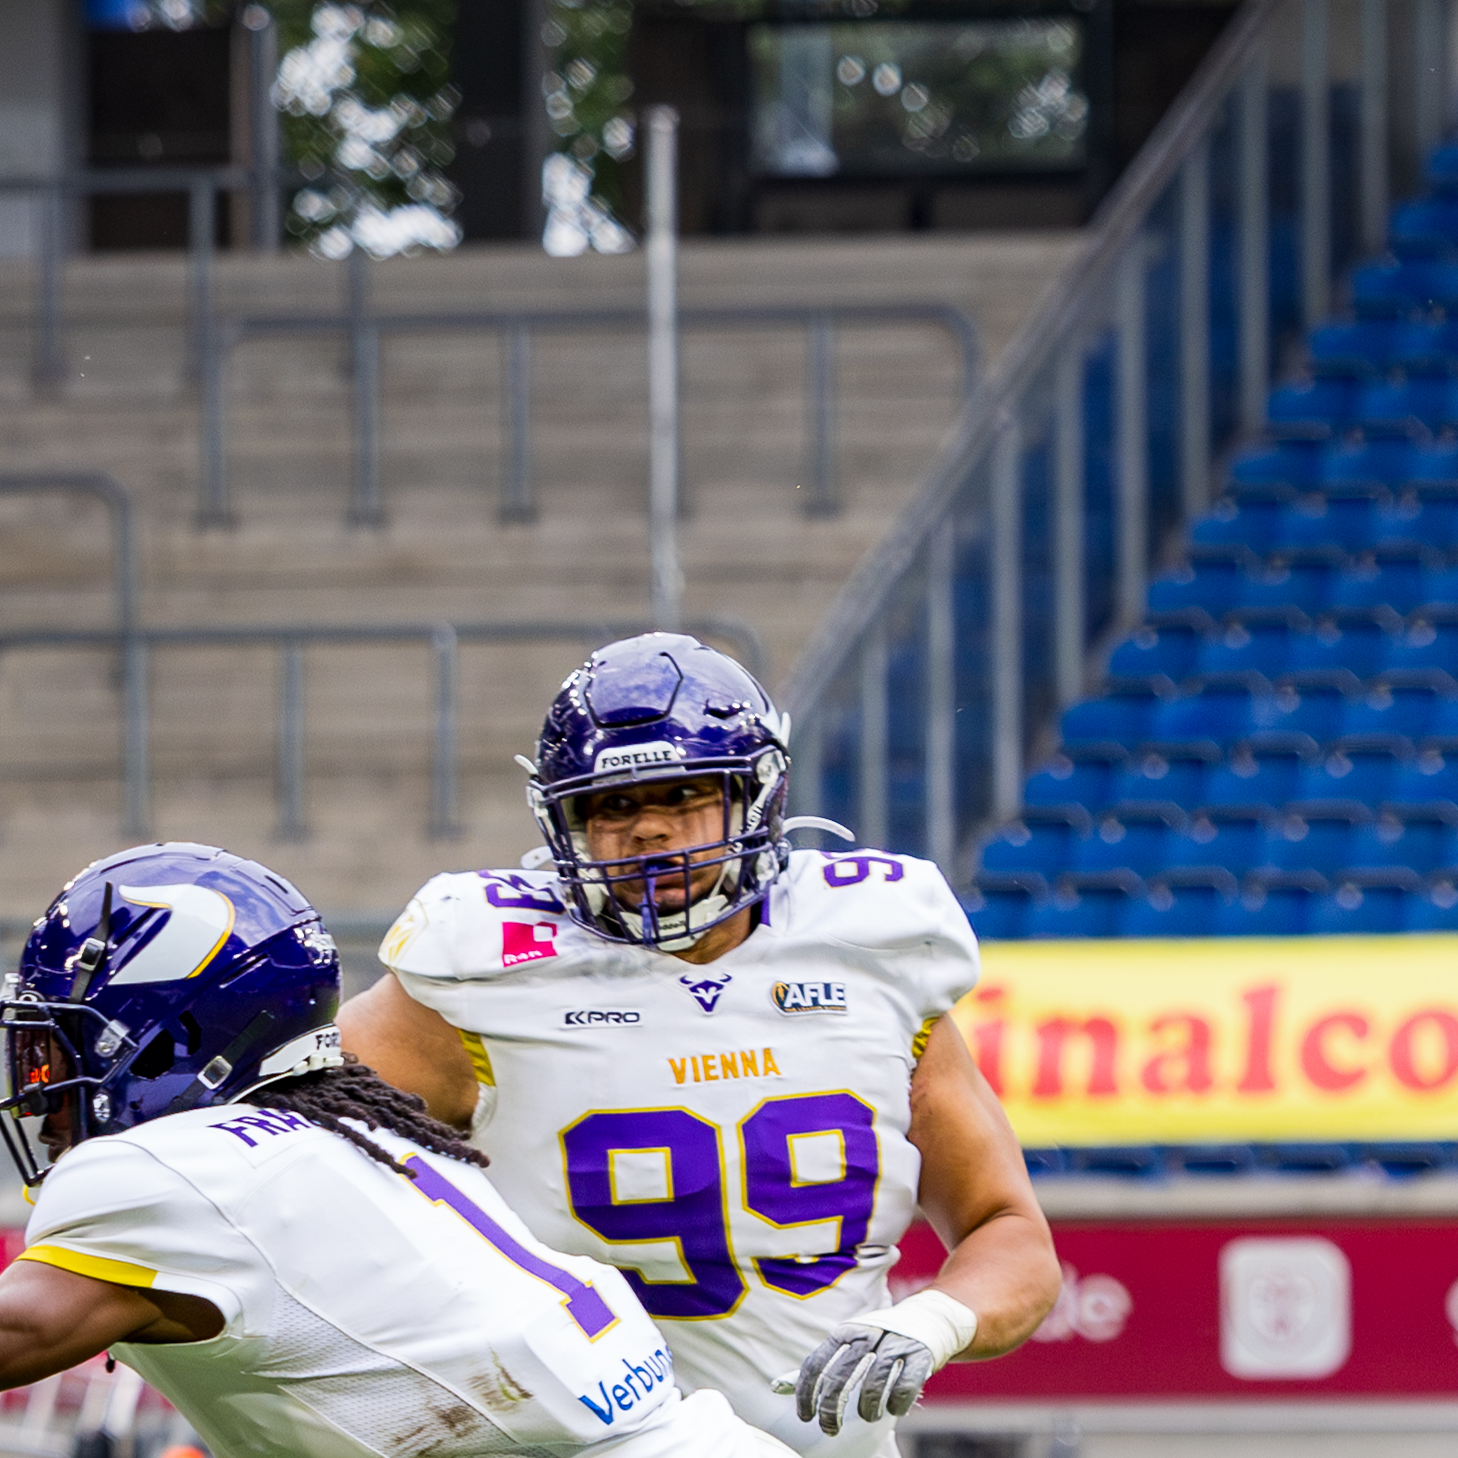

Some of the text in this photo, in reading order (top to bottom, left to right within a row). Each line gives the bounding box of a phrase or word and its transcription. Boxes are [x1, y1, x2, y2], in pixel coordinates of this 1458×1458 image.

[602, 750, 671, 768] FORELLE
[783, 982, 846, 1008] AFLE
[968, 976, 1458, 1098] inalco
[668, 1048, 781, 1084] VIENNA
[206, 1109, 312, 1148] FRA
[558, 1088, 880, 1320] 99
[397, 1151, 621, 1342] 1
